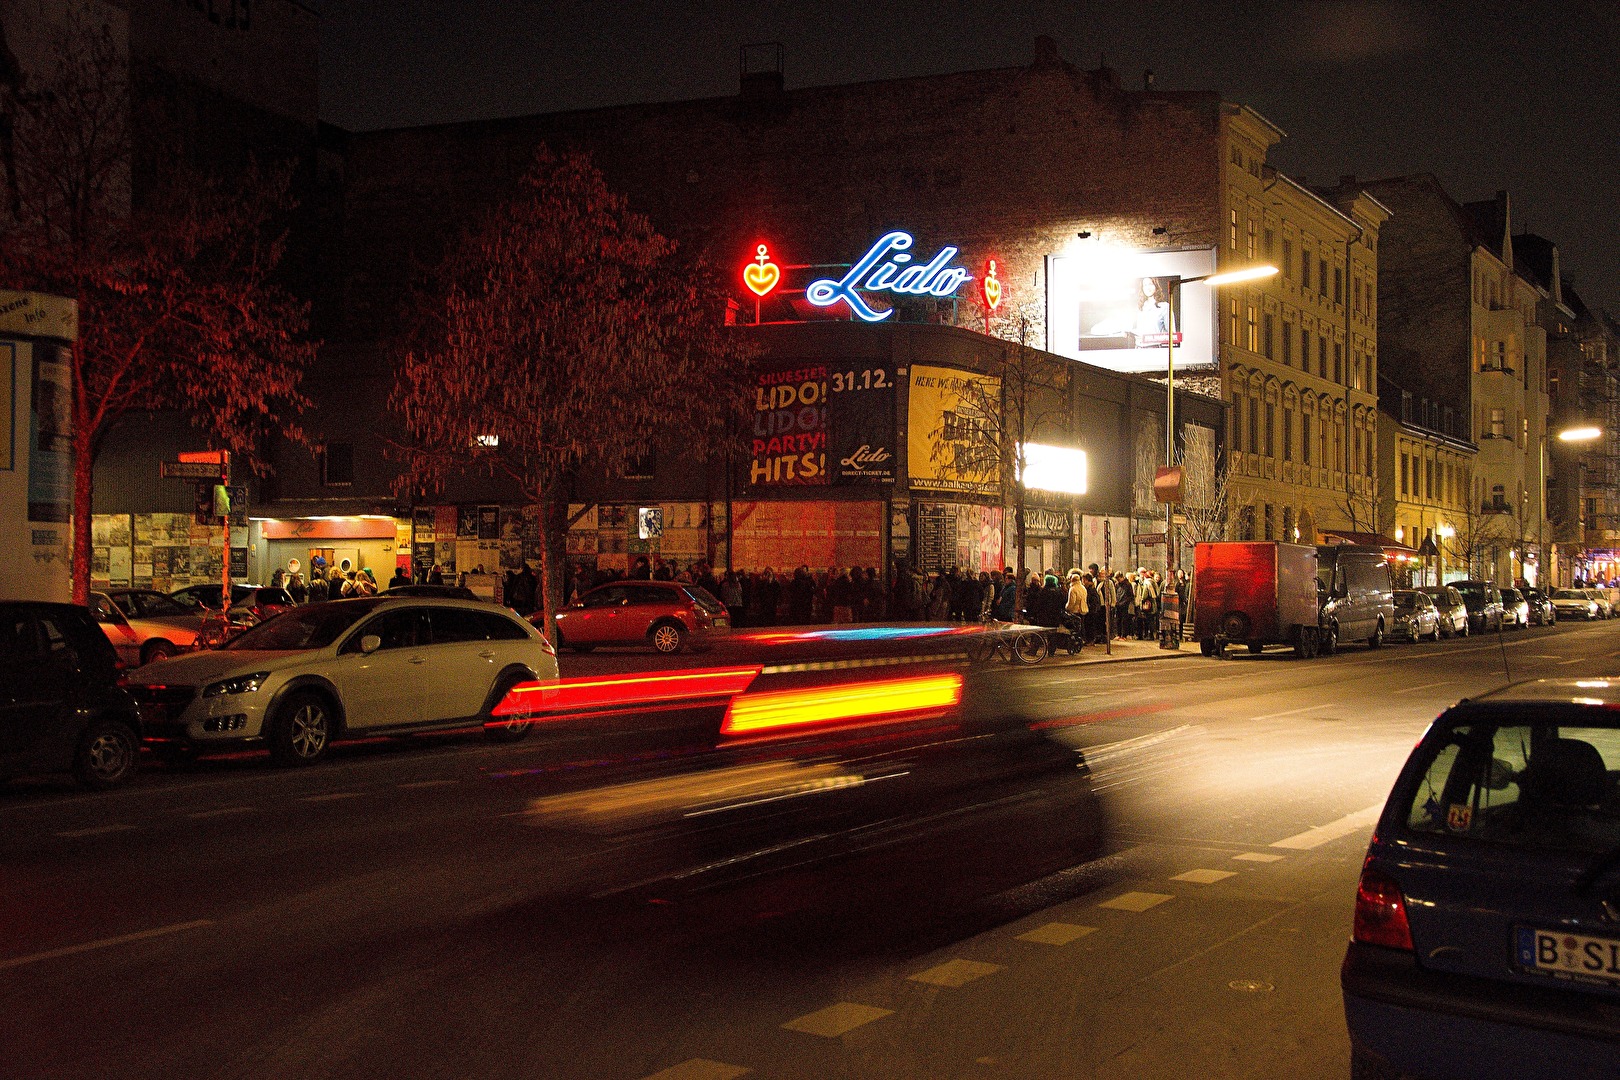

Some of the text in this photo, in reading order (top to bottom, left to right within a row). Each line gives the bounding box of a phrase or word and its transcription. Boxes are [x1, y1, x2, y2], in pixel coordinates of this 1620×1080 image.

[806, 231, 973, 321] Lido
[758, 365, 828, 386] SILVESTER
[832, 368, 893, 392] 31.12.
[915, 376, 936, 388] HERE
[937, 378, 950, 390] WE
[755, 381, 828, 411] LIDO!
[753, 406, 828, 437] LIDO!
[753, 432, 827, 457] PARTY!
[840, 444, 893, 470] Lido
[750, 452, 827, 484] HITS!
[1538, 935, 1558, 964] B
